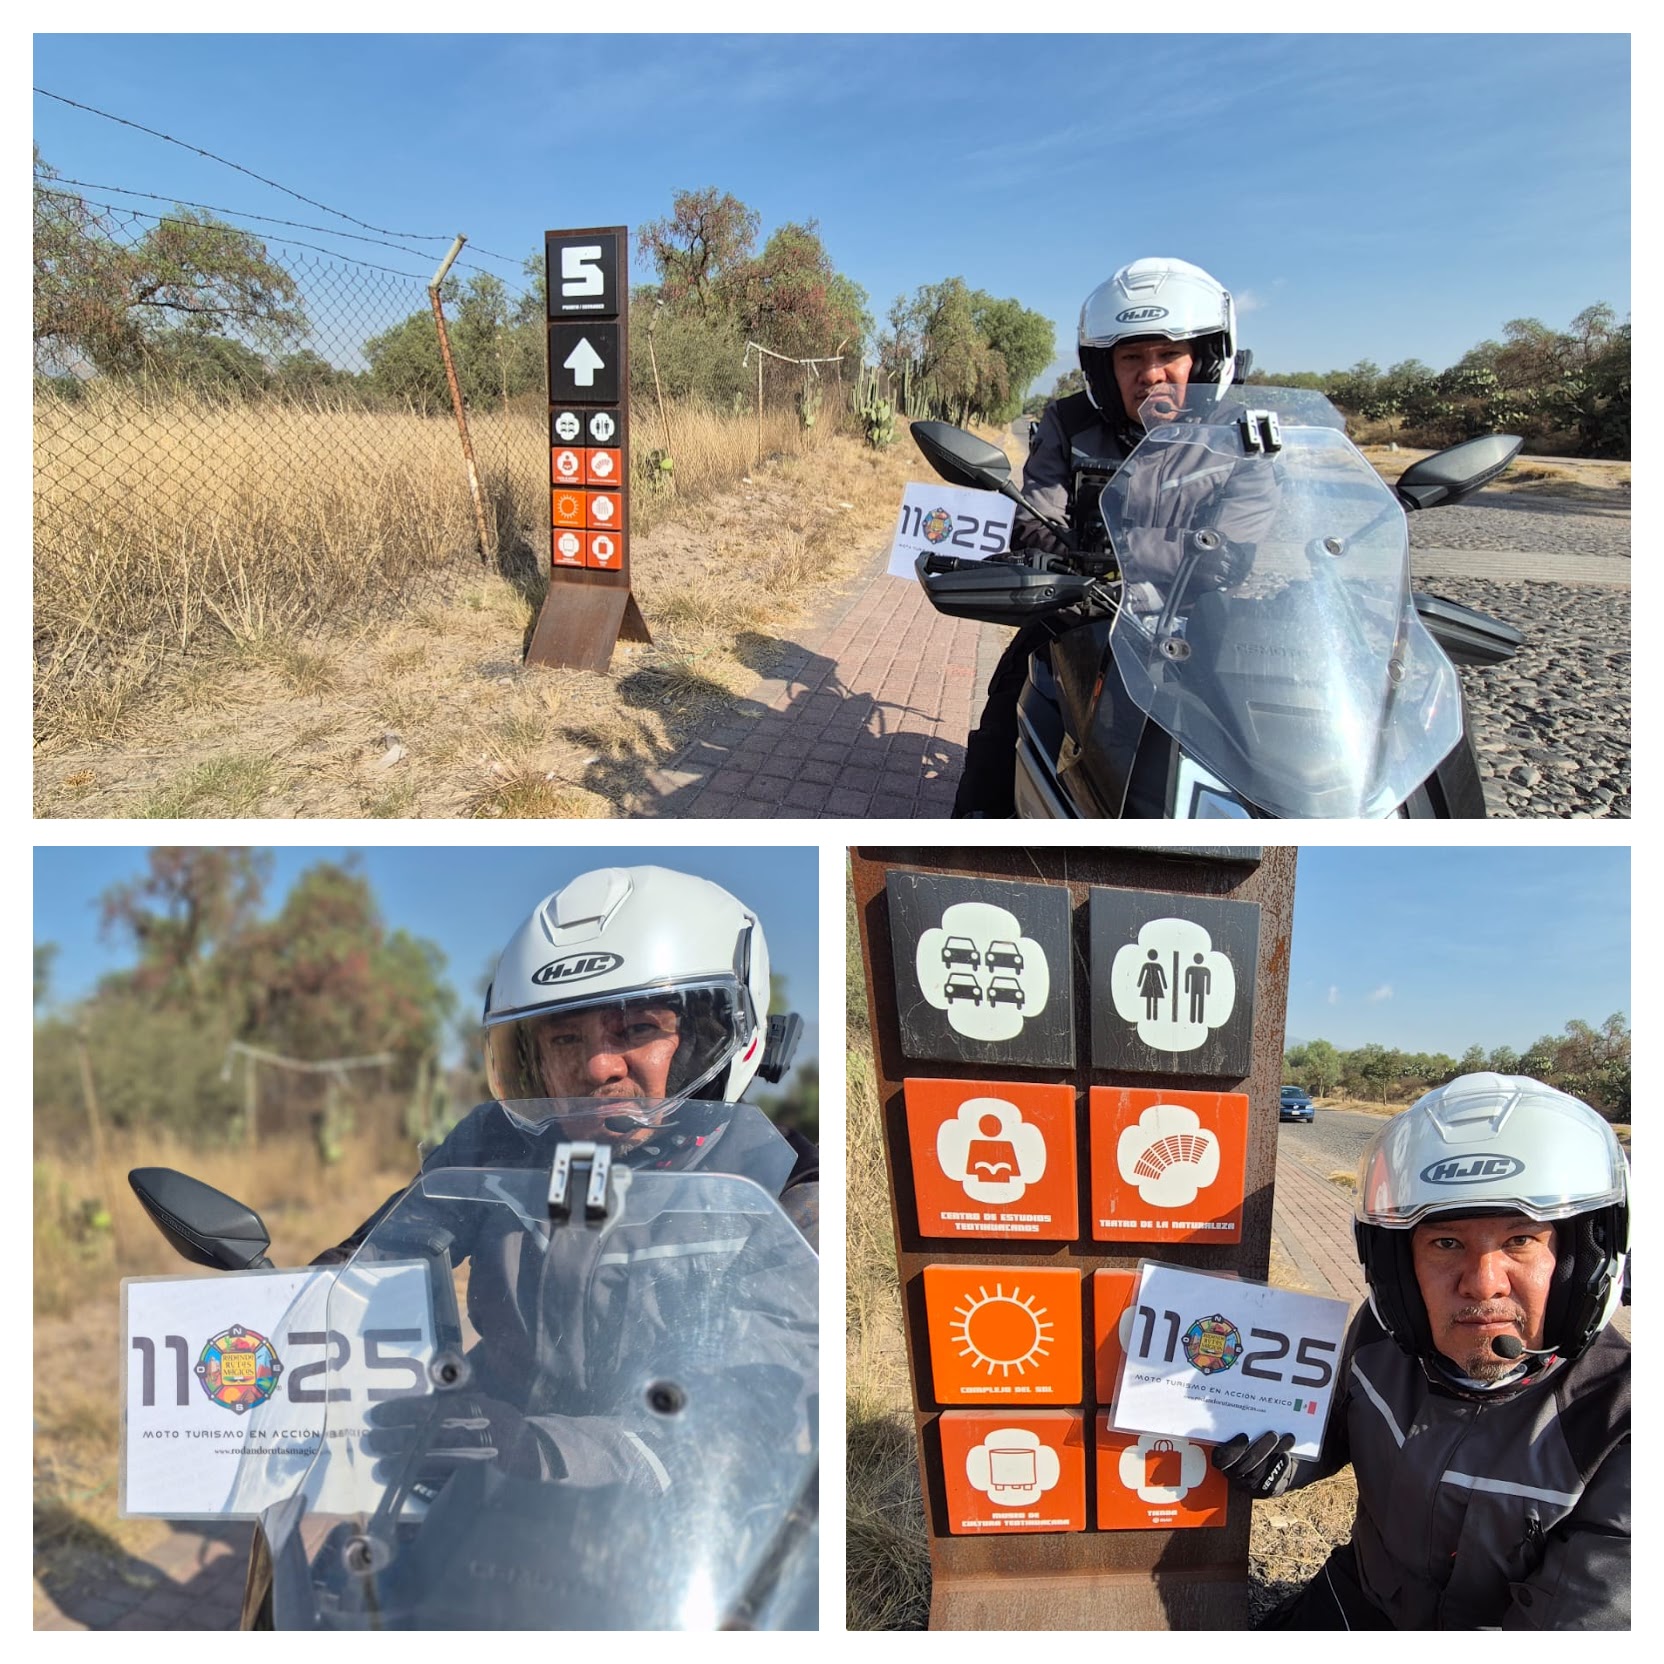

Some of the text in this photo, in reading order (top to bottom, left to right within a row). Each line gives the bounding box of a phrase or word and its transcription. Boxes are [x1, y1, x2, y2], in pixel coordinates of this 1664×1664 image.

[561, 246, 604, 297] 5
[1123, 307, 1162, 321] HJC
[951, 514, 1008, 553] 25
[541, 955, 610, 981] HJC
[1432, 1159, 1511, 1181] HJC
[940, 1211, 1052, 1222] CENTRO DE ESTUDIOS
[1099, 1219, 1235, 1230] TEATRO DE LA NATURALEZA
[232, 1327, 242, 1335] N
[1240, 1327, 1337, 1389] 25
[287, 1328, 429, 1404] 25
[960, 1386, 1012, 1394] COMPLEJO
[1035, 1385, 1053, 1393] SOL
[1135, 1374, 1161, 1383] MOTO
[1166, 1379, 1206, 1391] TURISMO
[142, 1431, 180, 1439] MOTO
[186, 1430, 244, 1439] TURISMO
[249, 1430, 266, 1439] EN
[272, 1428, 320, 1439] ACCIÓN
[1146, 1509, 1178, 1517] TIENDA
